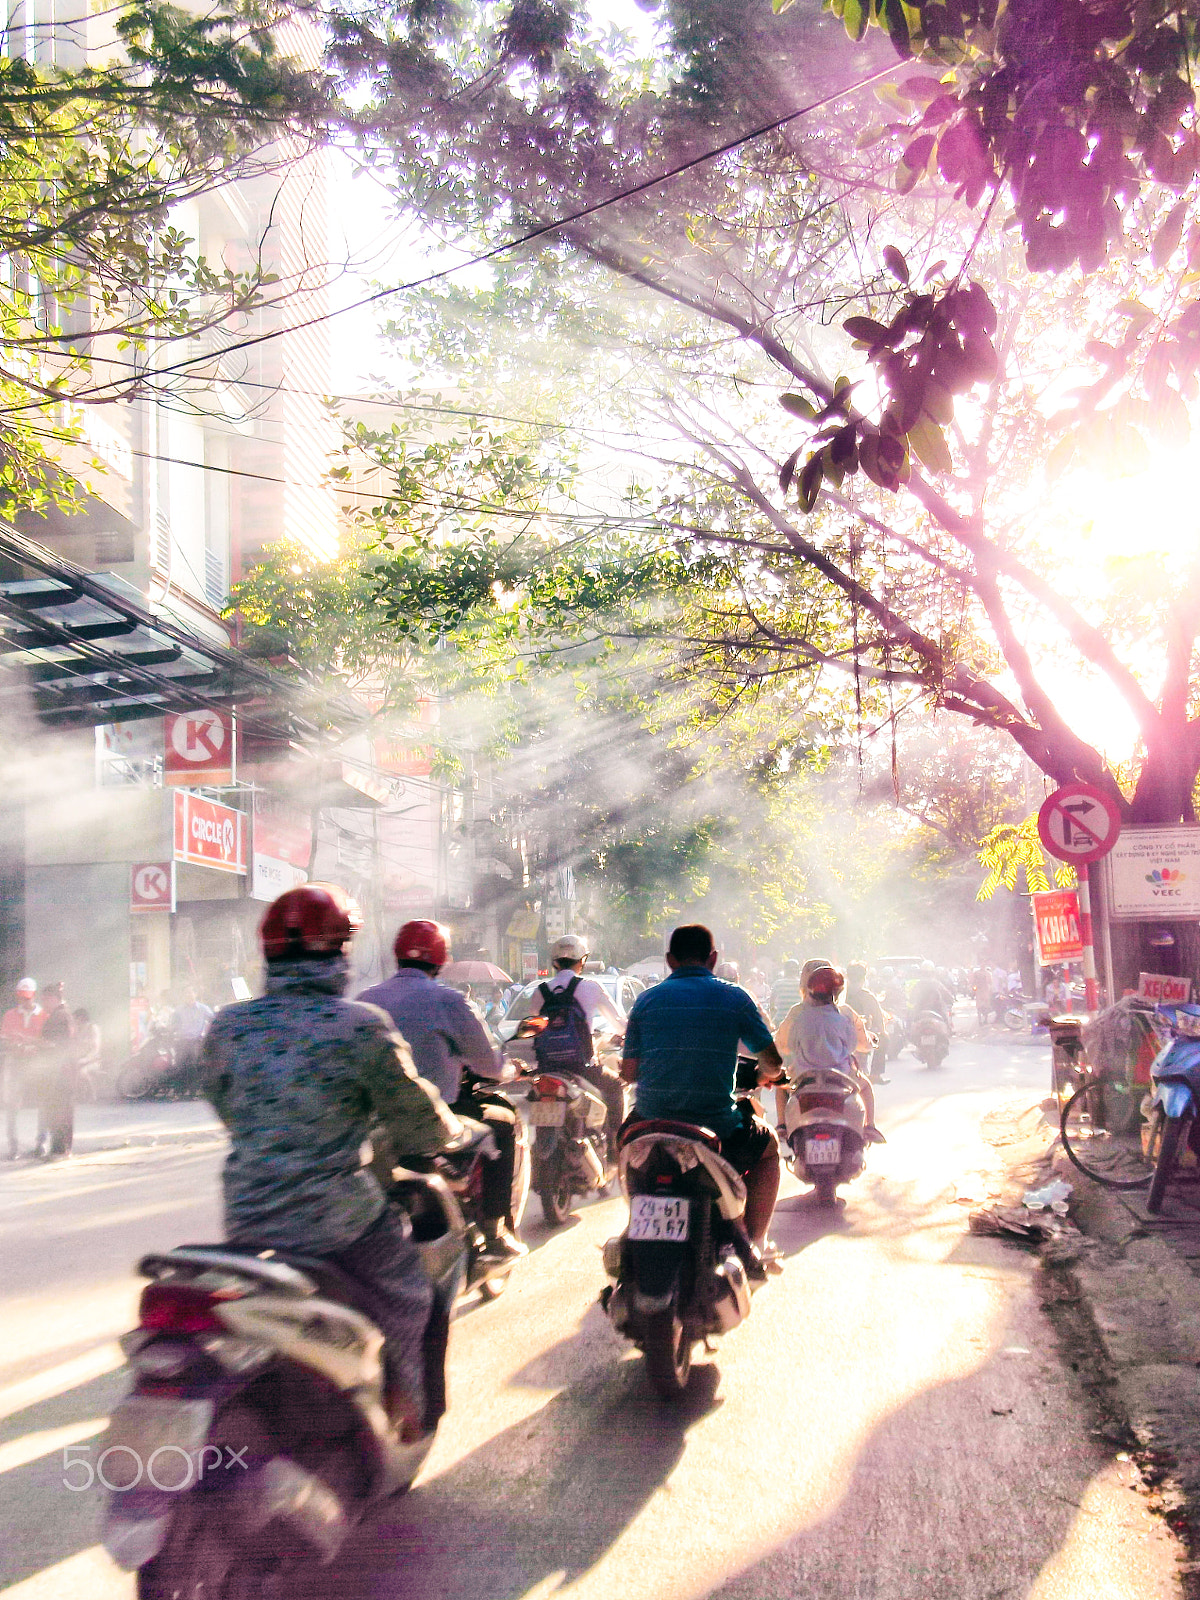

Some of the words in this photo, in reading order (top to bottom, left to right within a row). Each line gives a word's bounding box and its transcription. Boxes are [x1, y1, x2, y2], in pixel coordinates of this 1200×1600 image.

[191, 815, 222, 845] CIRCLE
[223, 818, 235, 854] K
[1152, 889, 1182, 897] VEEC
[1143, 979, 1161, 998] XE
